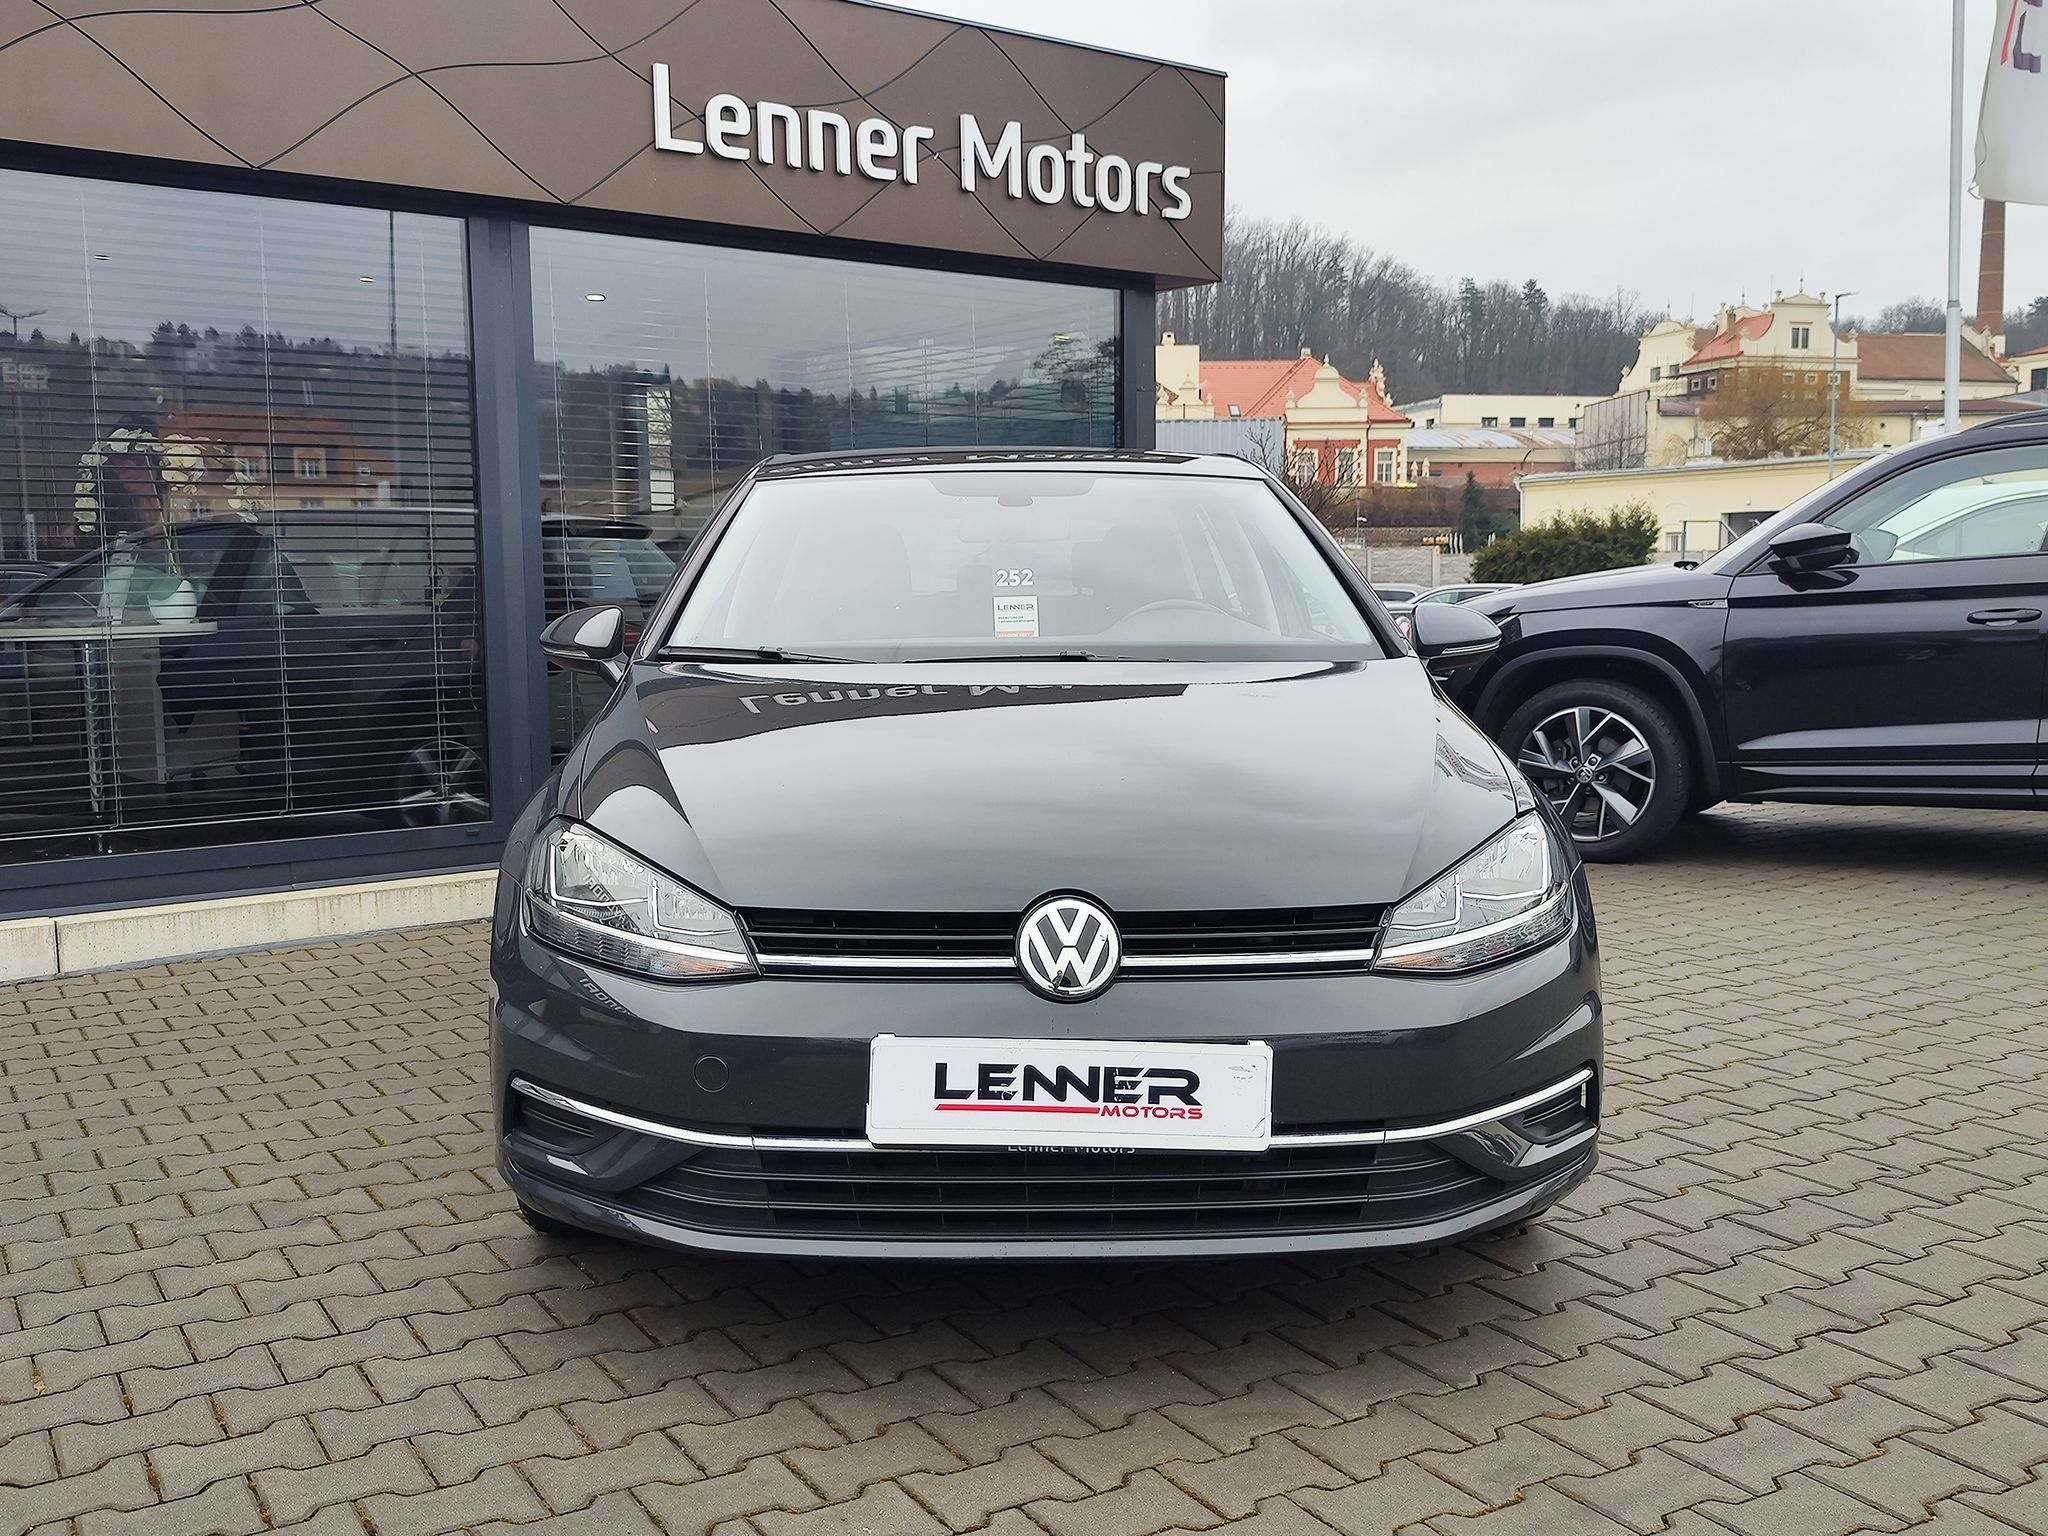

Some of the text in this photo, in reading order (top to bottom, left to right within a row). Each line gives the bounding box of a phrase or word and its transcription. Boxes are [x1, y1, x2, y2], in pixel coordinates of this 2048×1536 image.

[652, 62, 1192, 221] Lenner Motors
[995, 568, 1035, 587] 252
[997, 603, 1035, 611] LENNER
[1020, 898, 1119, 995] VW
[934, 1062, 1203, 1106] LENNER
[1100, 1104, 1203, 1120] MOTORS
